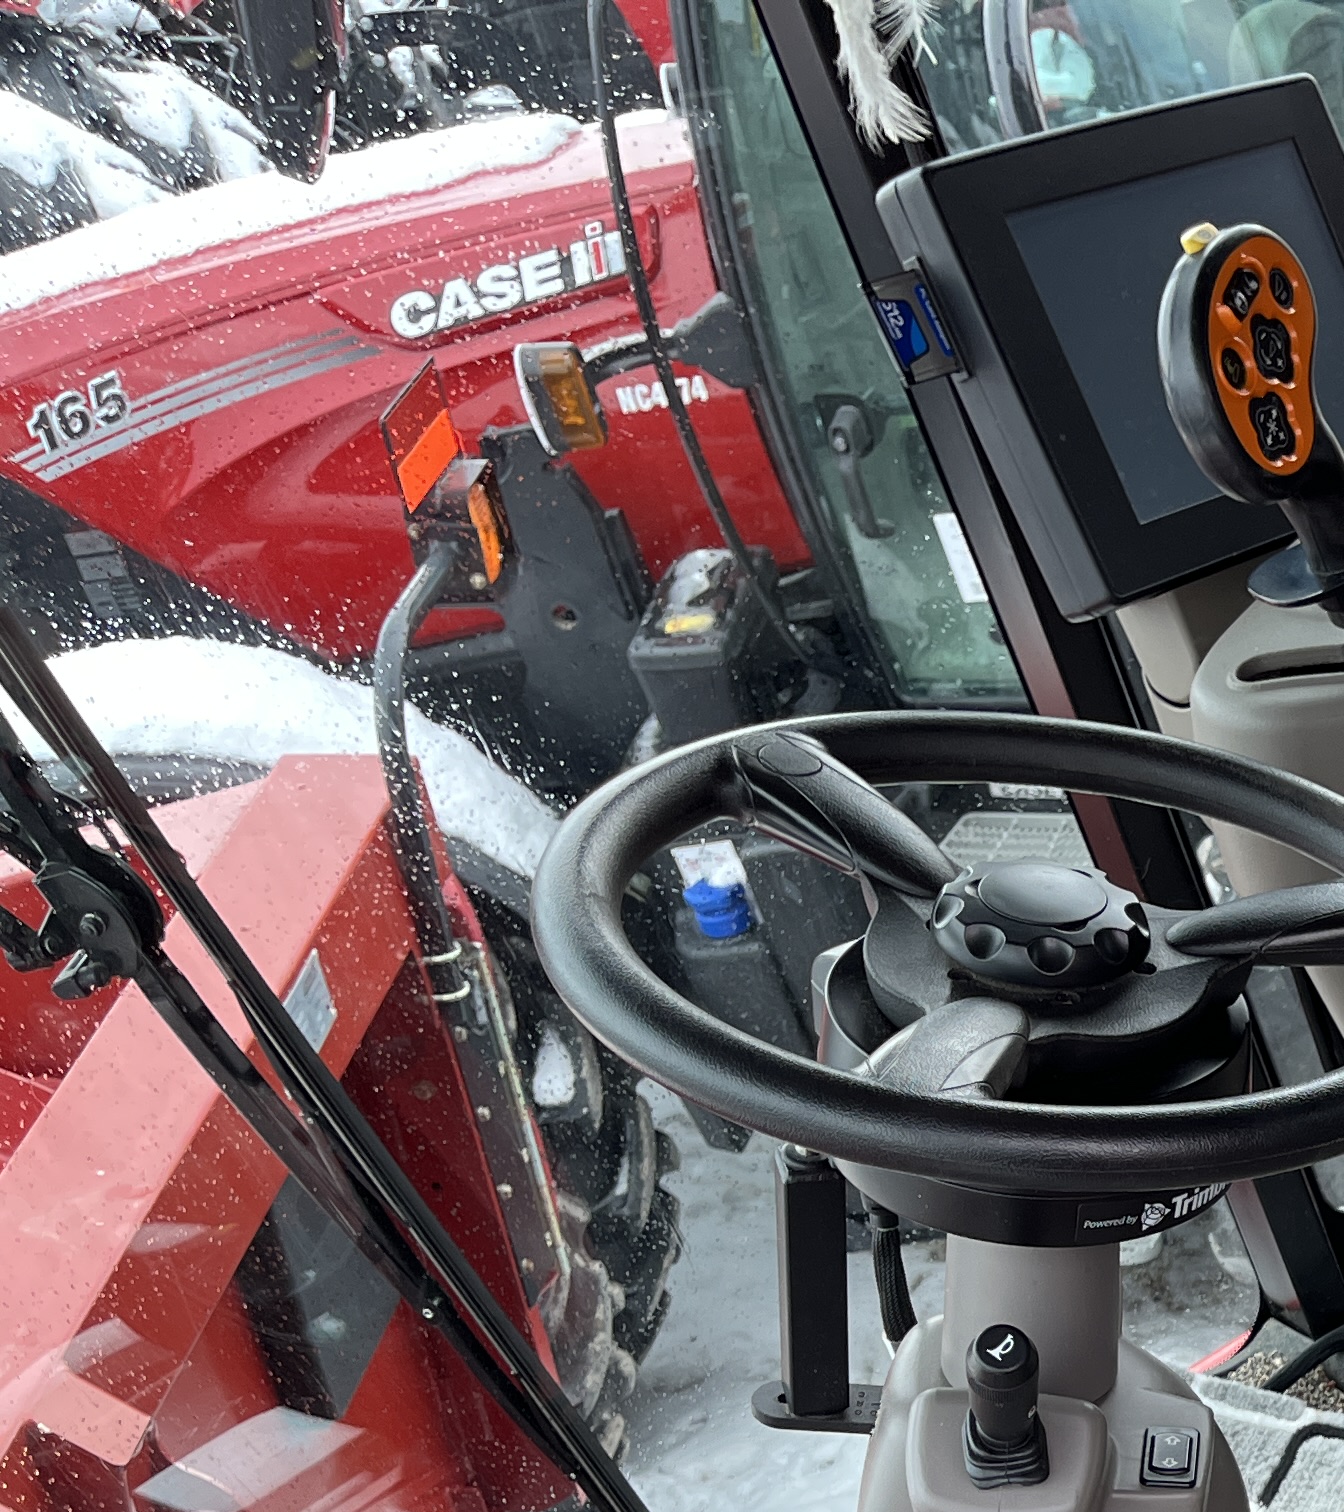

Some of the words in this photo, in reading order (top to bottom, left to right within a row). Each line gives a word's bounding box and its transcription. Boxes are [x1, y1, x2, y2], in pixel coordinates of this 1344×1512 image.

[390, 250, 566, 339] CASE
[881, 301, 905, 328] 512
[26, 369, 130, 456] 165
[1083, 1217, 1126, 1229] Powered
[1126, 1215, 1139, 1225] by
